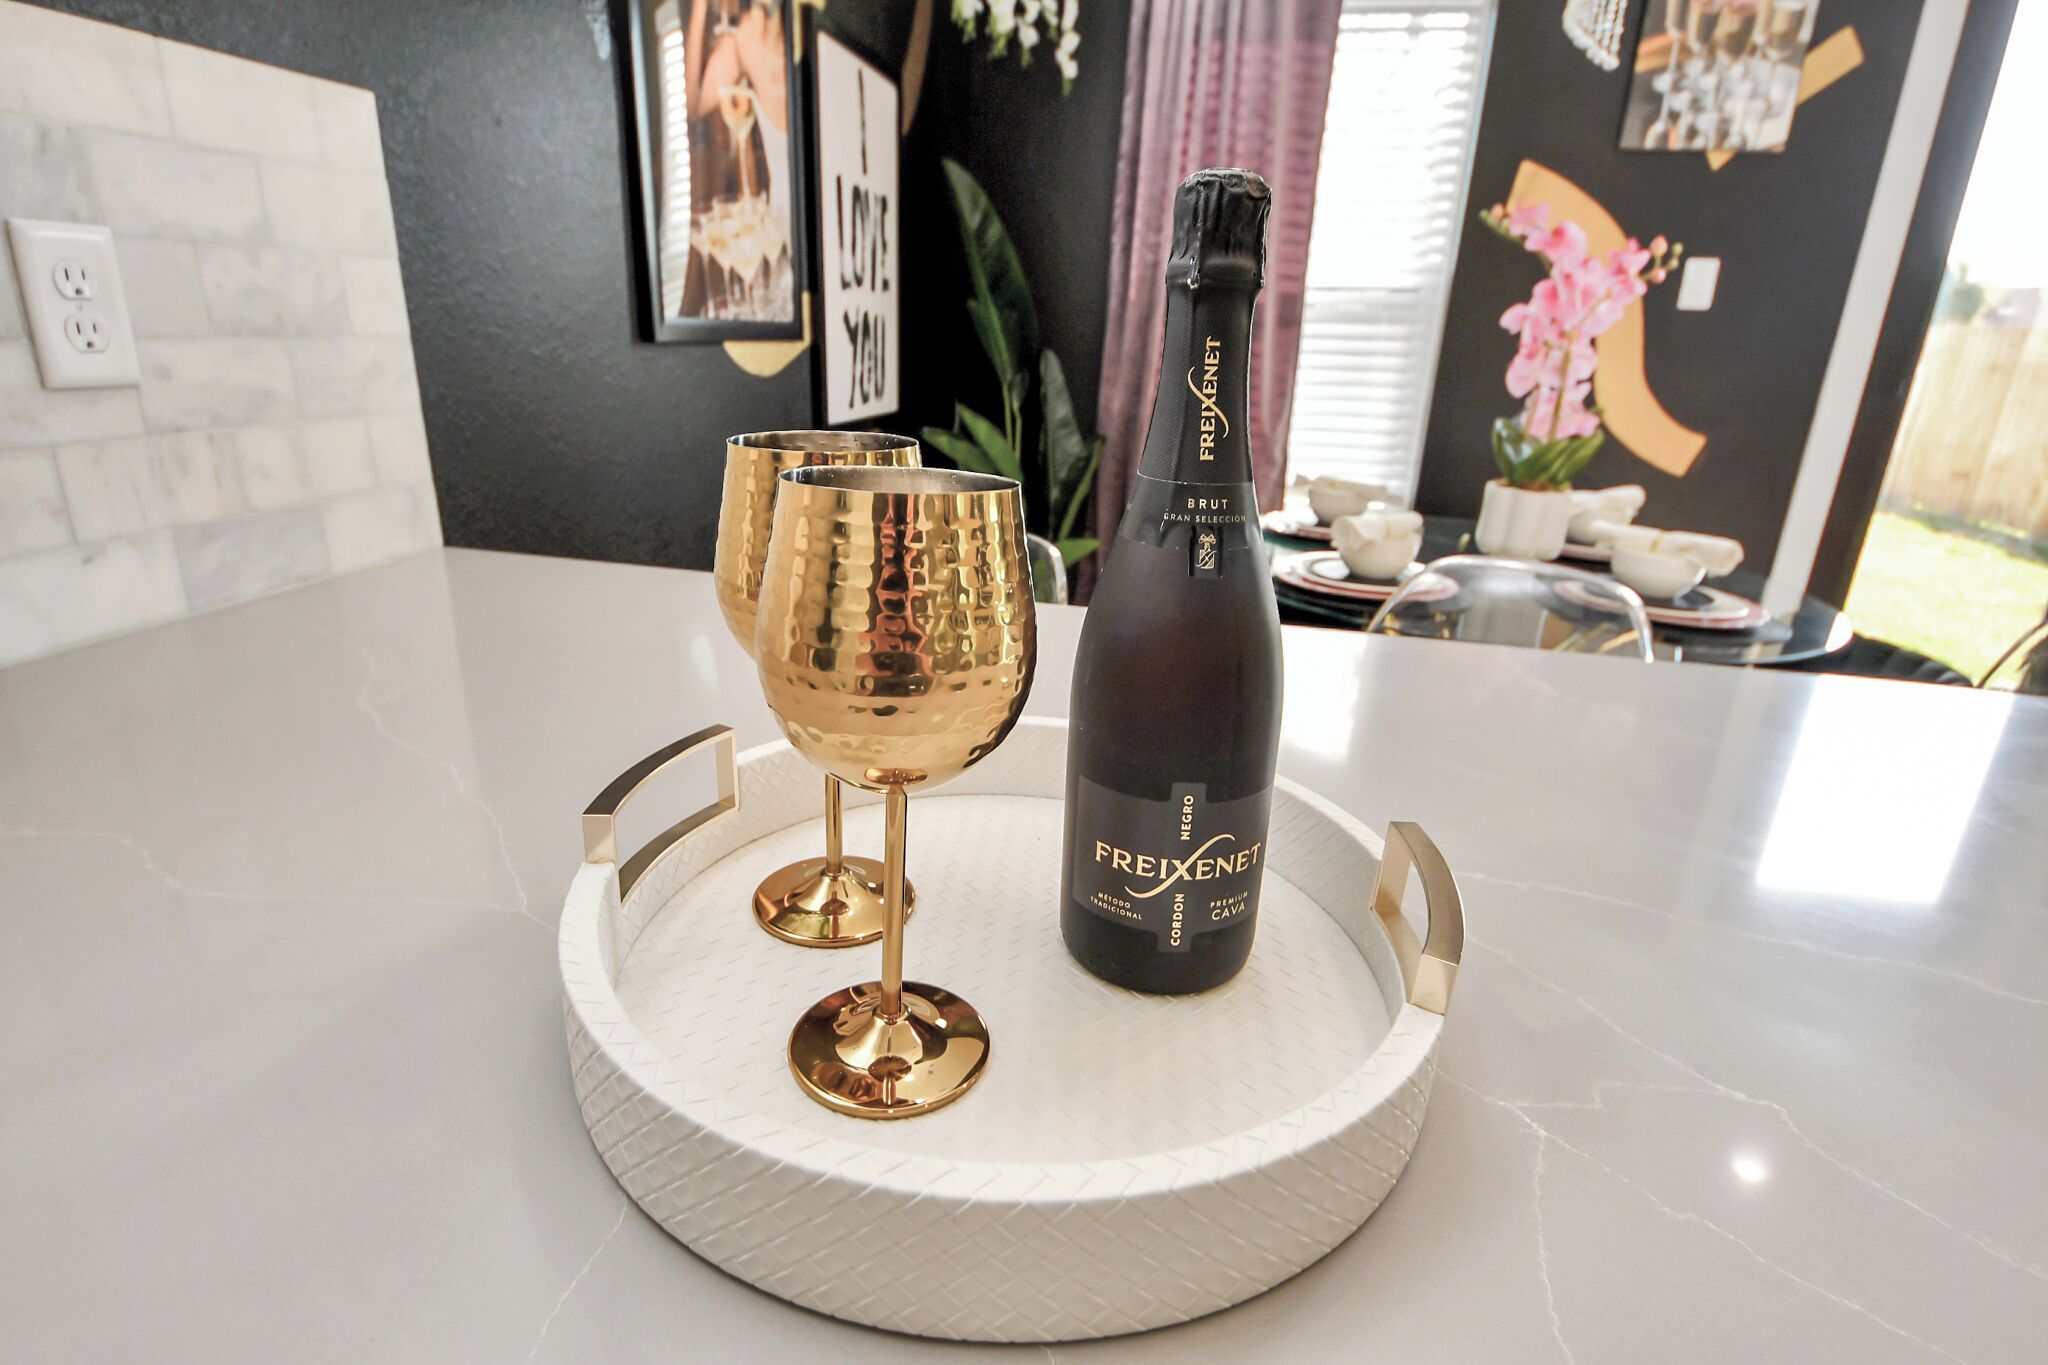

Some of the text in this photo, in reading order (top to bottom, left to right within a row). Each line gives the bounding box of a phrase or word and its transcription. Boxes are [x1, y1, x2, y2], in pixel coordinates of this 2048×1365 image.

[857, 68, 867, 174] I
[836, 174, 889, 292] LOVE
[843, 308, 885, 409] YOU
[1188, 336, 1229, 461] FREIXENET
[1163, 512, 1191, 522] GRAN
[1187, 498, 1228, 510] BRUT
[1180, 795, 1194, 840] NEGRO
[1095, 834, 1261, 898] FREIXENET
[1090, 896, 1142, 920] TRADICIONAL
[1170, 893, 1185, 946] CORDON
[1210, 891, 1248, 908] PREMIUM
[1211, 901, 1245, 920] CAVA
